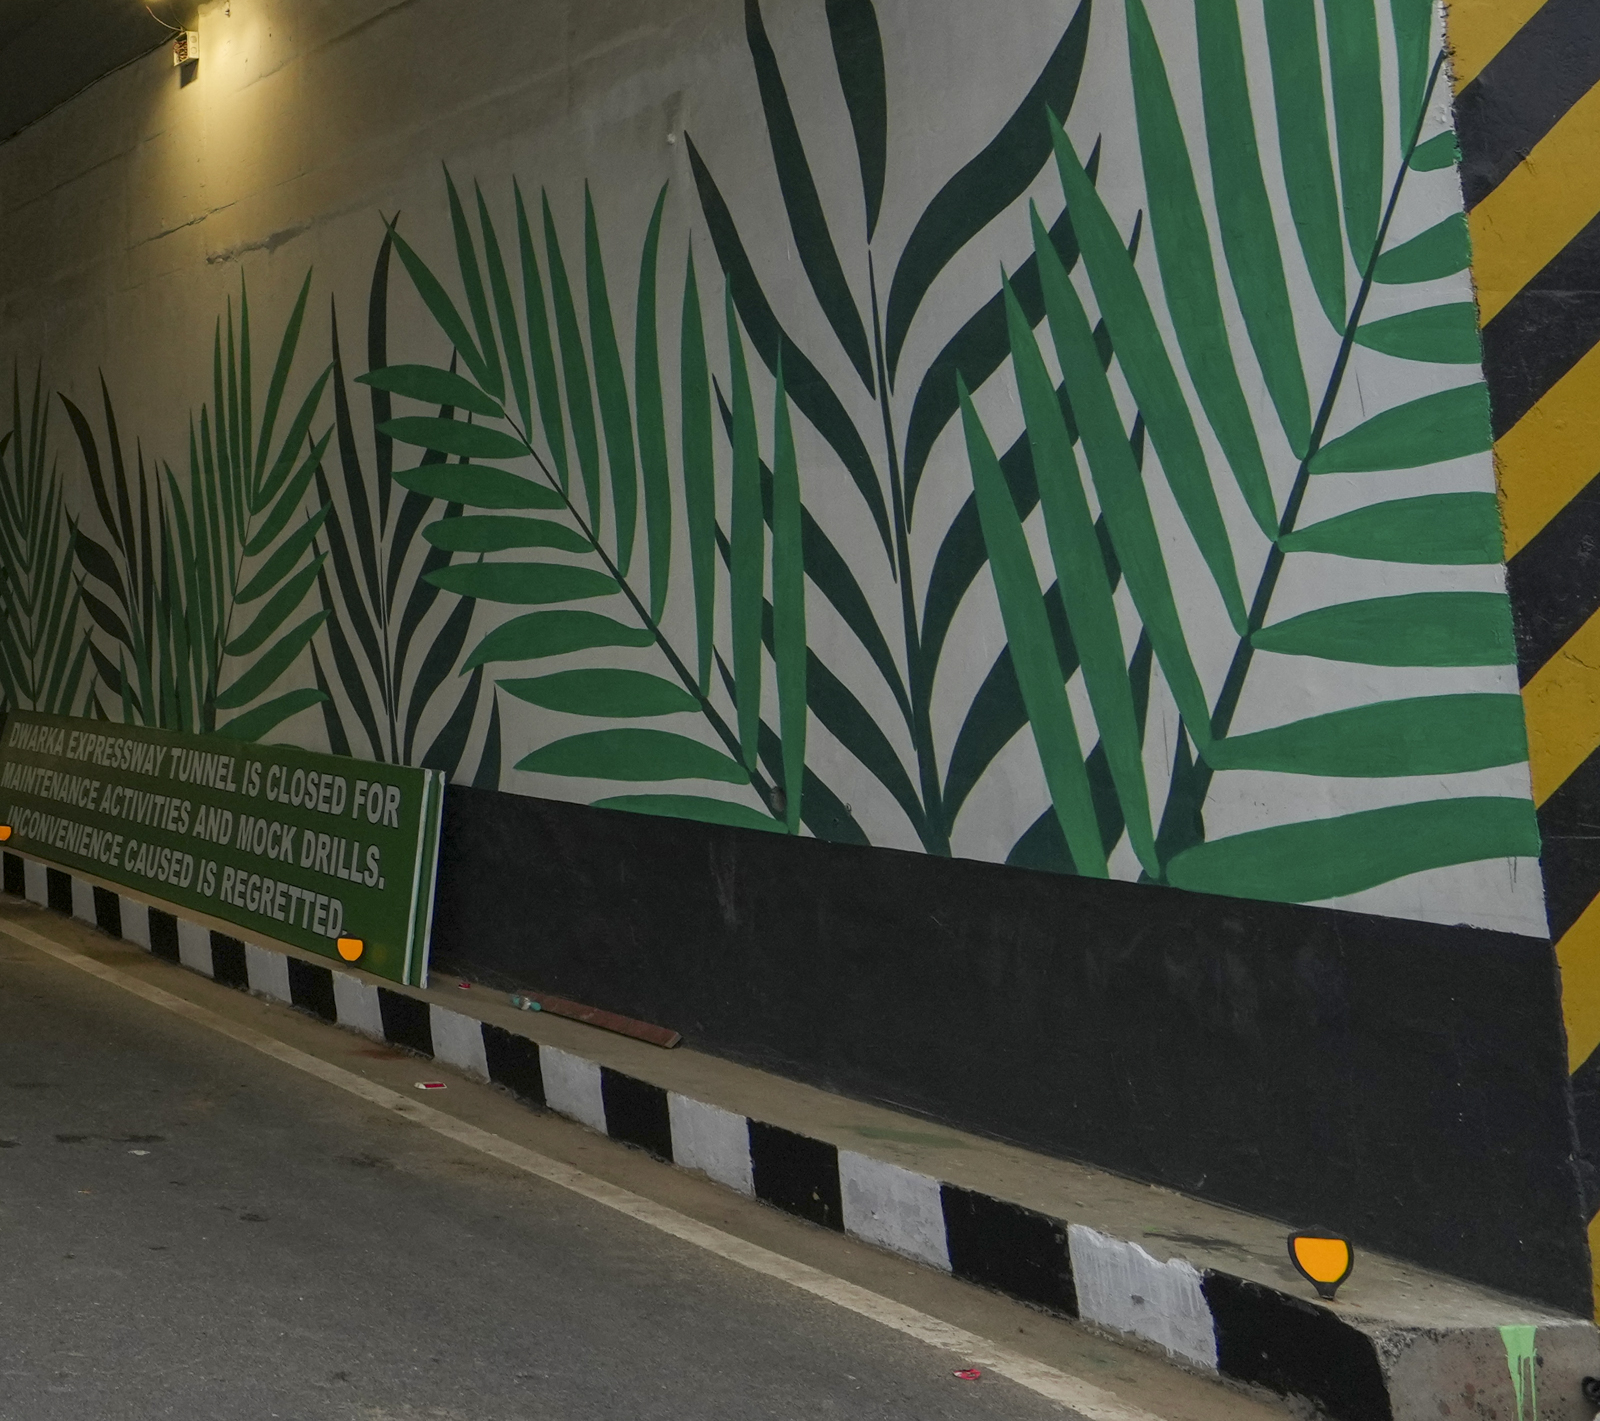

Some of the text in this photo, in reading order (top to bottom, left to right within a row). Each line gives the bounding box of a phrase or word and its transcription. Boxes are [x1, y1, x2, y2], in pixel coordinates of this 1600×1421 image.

[0, 762, 385, 890] MAINTENANCE ACTIVITIES AND MOCK DRILLS.
[8, 722, 401, 828] DWARKA EXPRESSWAY TUNNEL IS CLOSED FOR
[6, 805, 123, 867] INCONVENIENCE
[124, 839, 194, 889] CAUSED
[197, 859, 217, 897] IS
